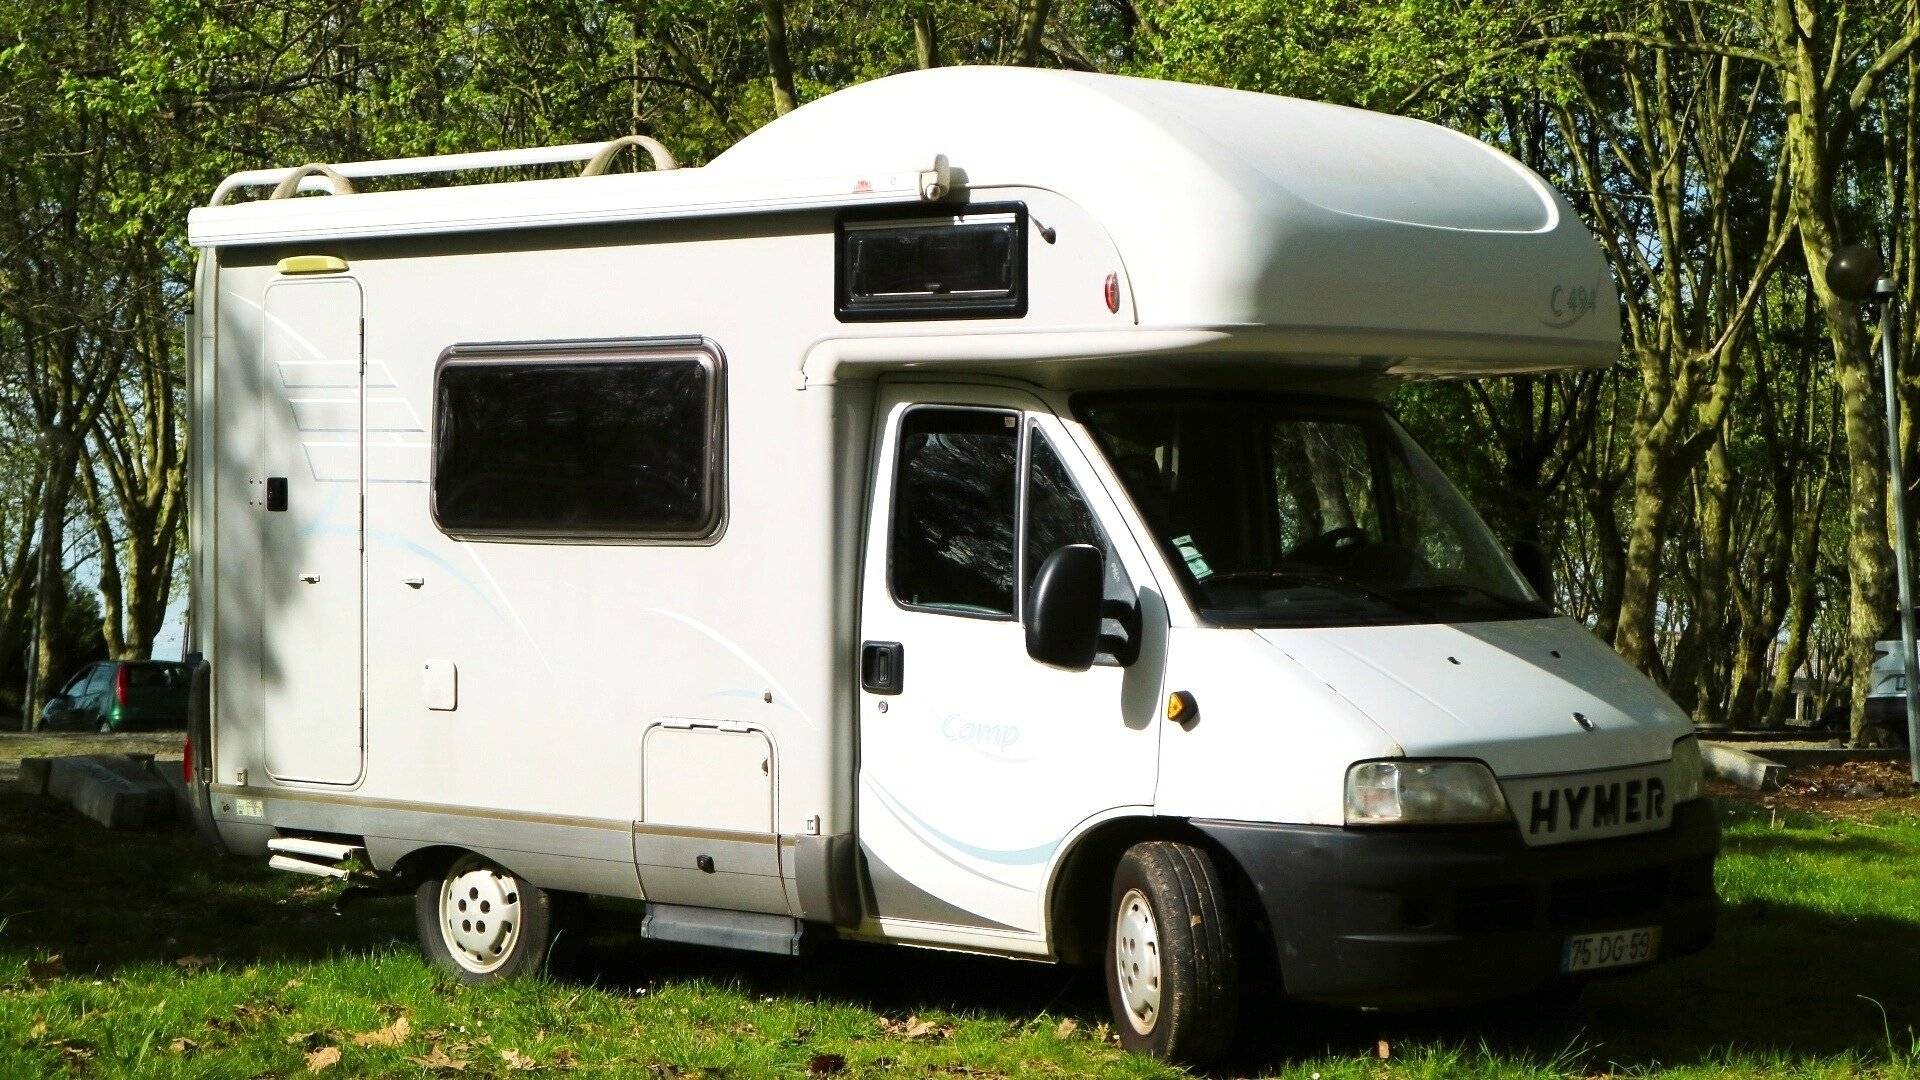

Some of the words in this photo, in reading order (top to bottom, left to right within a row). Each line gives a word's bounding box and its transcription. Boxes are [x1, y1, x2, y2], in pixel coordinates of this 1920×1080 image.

[1550, 284, 1562, 317] C
[942, 713, 1020, 752] Camp
[1530, 777, 1665, 834] HYMER
